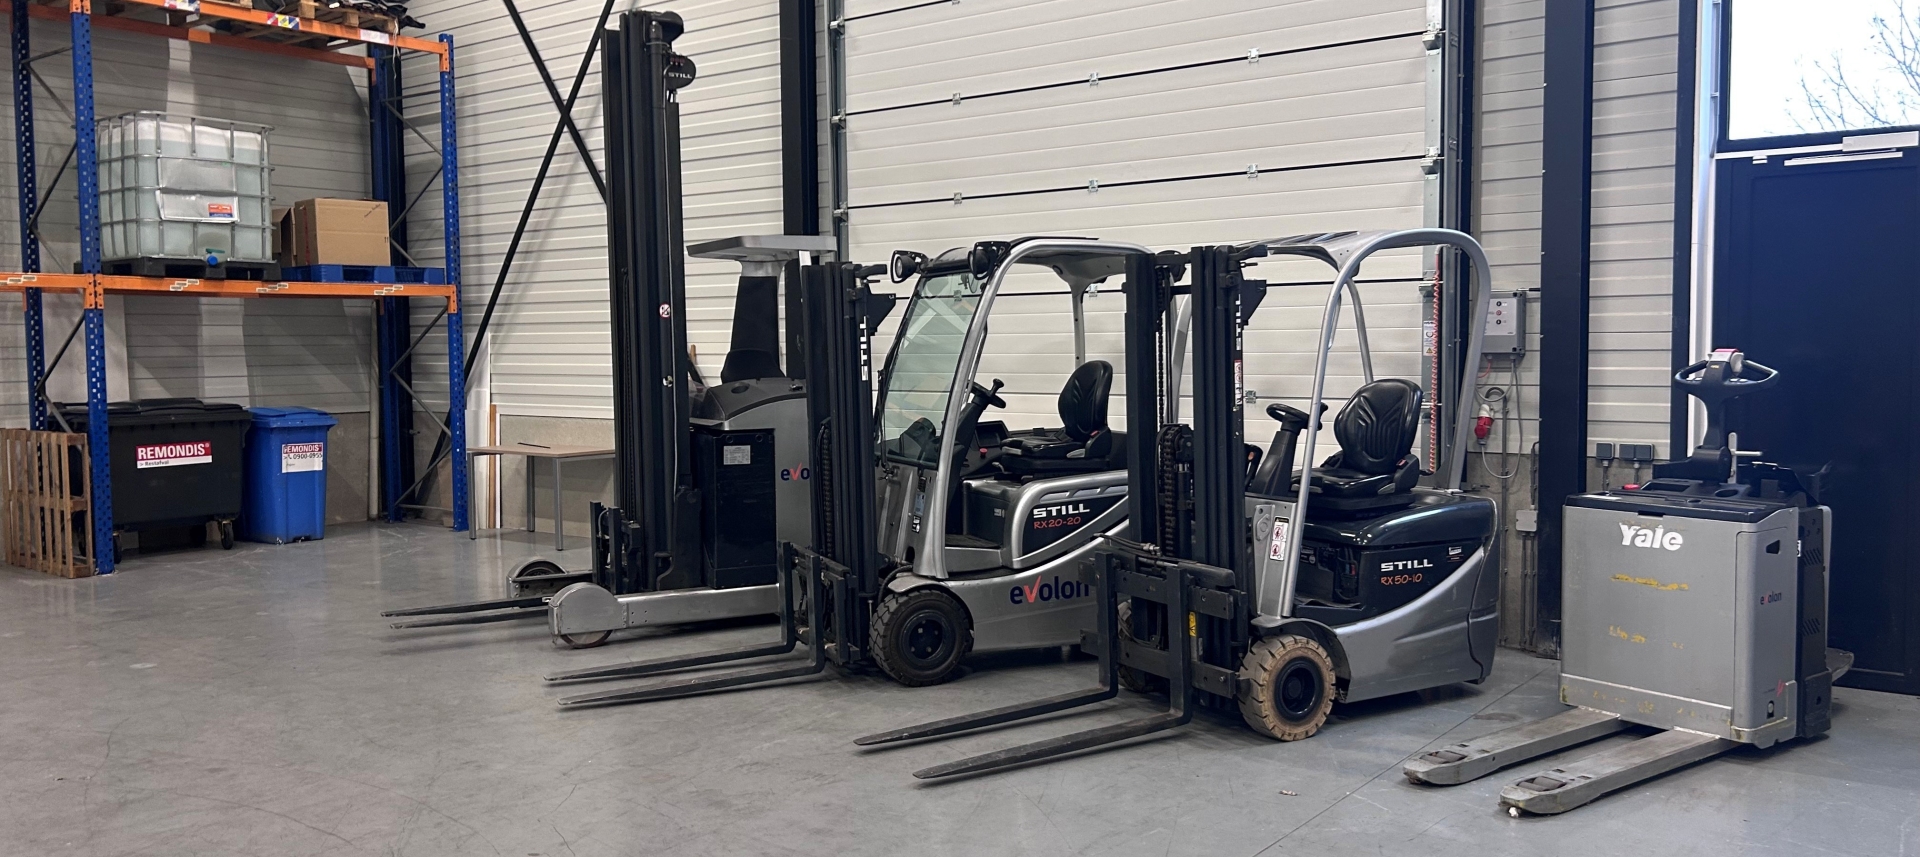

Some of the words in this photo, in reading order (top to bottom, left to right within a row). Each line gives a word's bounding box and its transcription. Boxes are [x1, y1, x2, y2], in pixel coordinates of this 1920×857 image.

[860, 316, 868, 380] STILL
[1033, 503, 1090, 518] STILL
[1619, 522, 1683, 551] Yale
[1381, 559, 1433, 571] STILL
[1010, 575, 1089, 604] evolon
